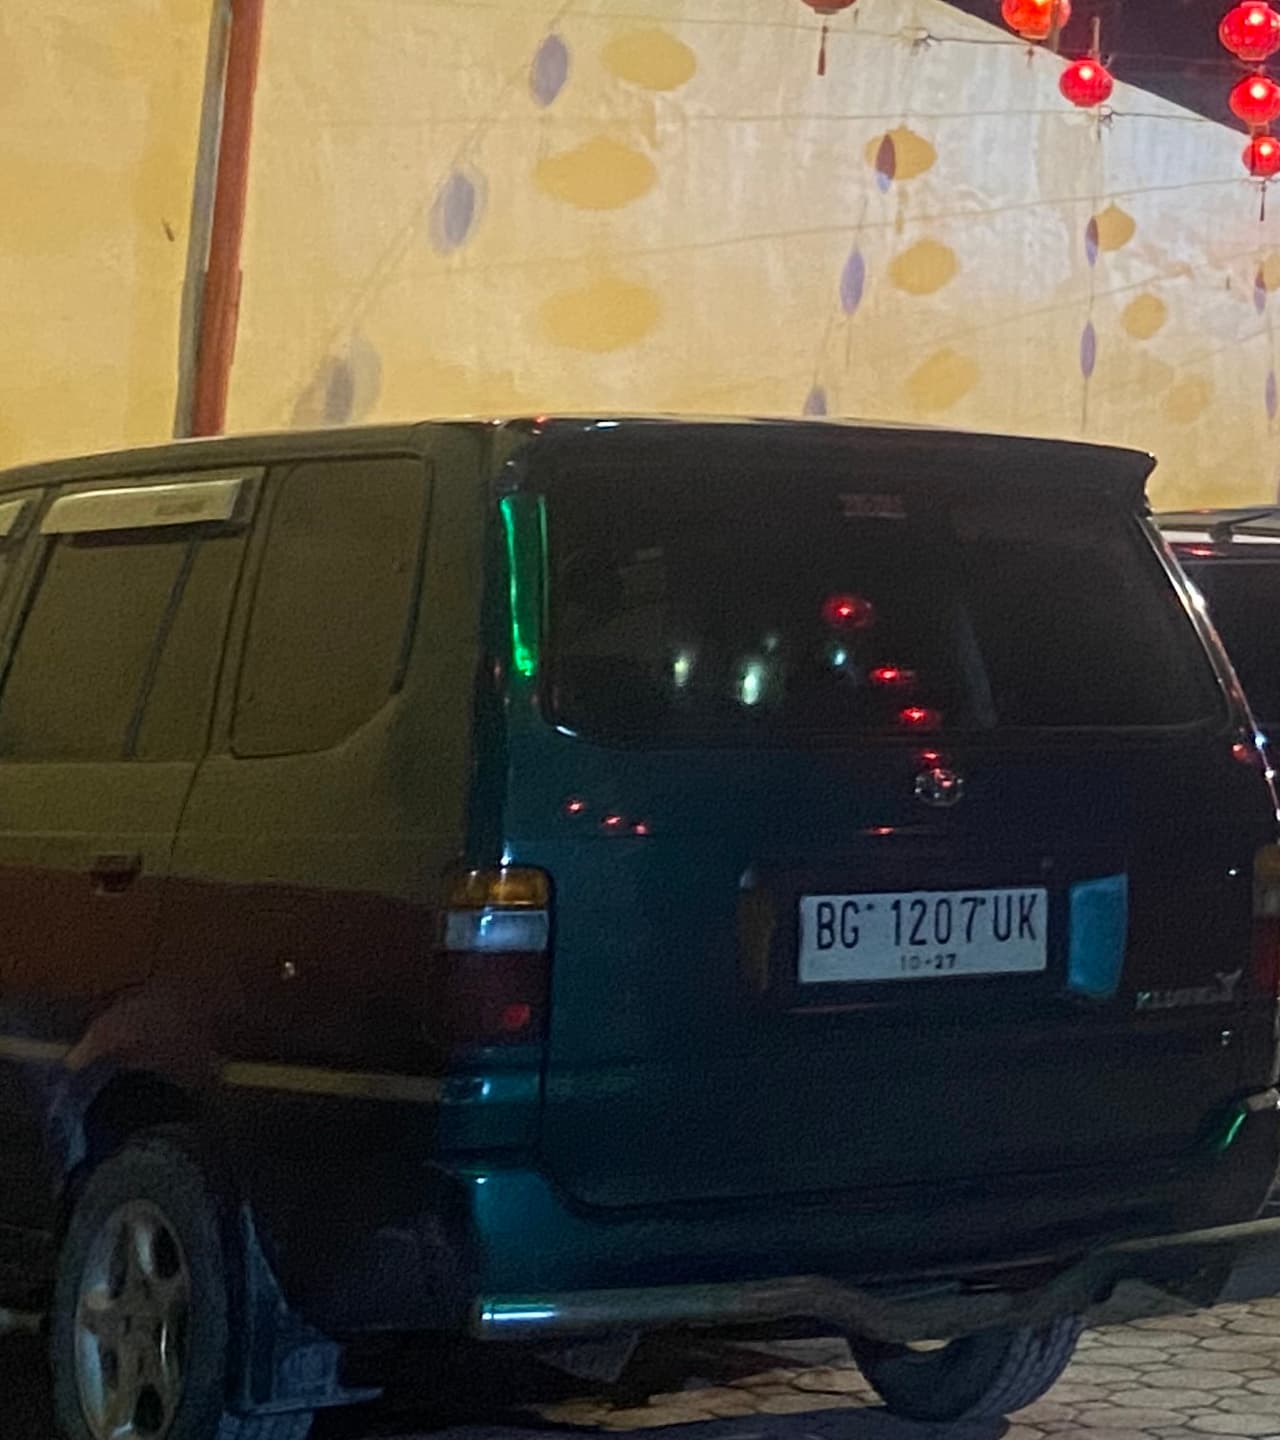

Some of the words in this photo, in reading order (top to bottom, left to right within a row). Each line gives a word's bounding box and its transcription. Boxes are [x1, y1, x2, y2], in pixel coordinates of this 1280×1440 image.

[817, 901, 859, 950] BG
[891, 898, 978, 946] 1207
[993, 894, 1037, 941] UK
[901, 953, 957, 971] 10-27
